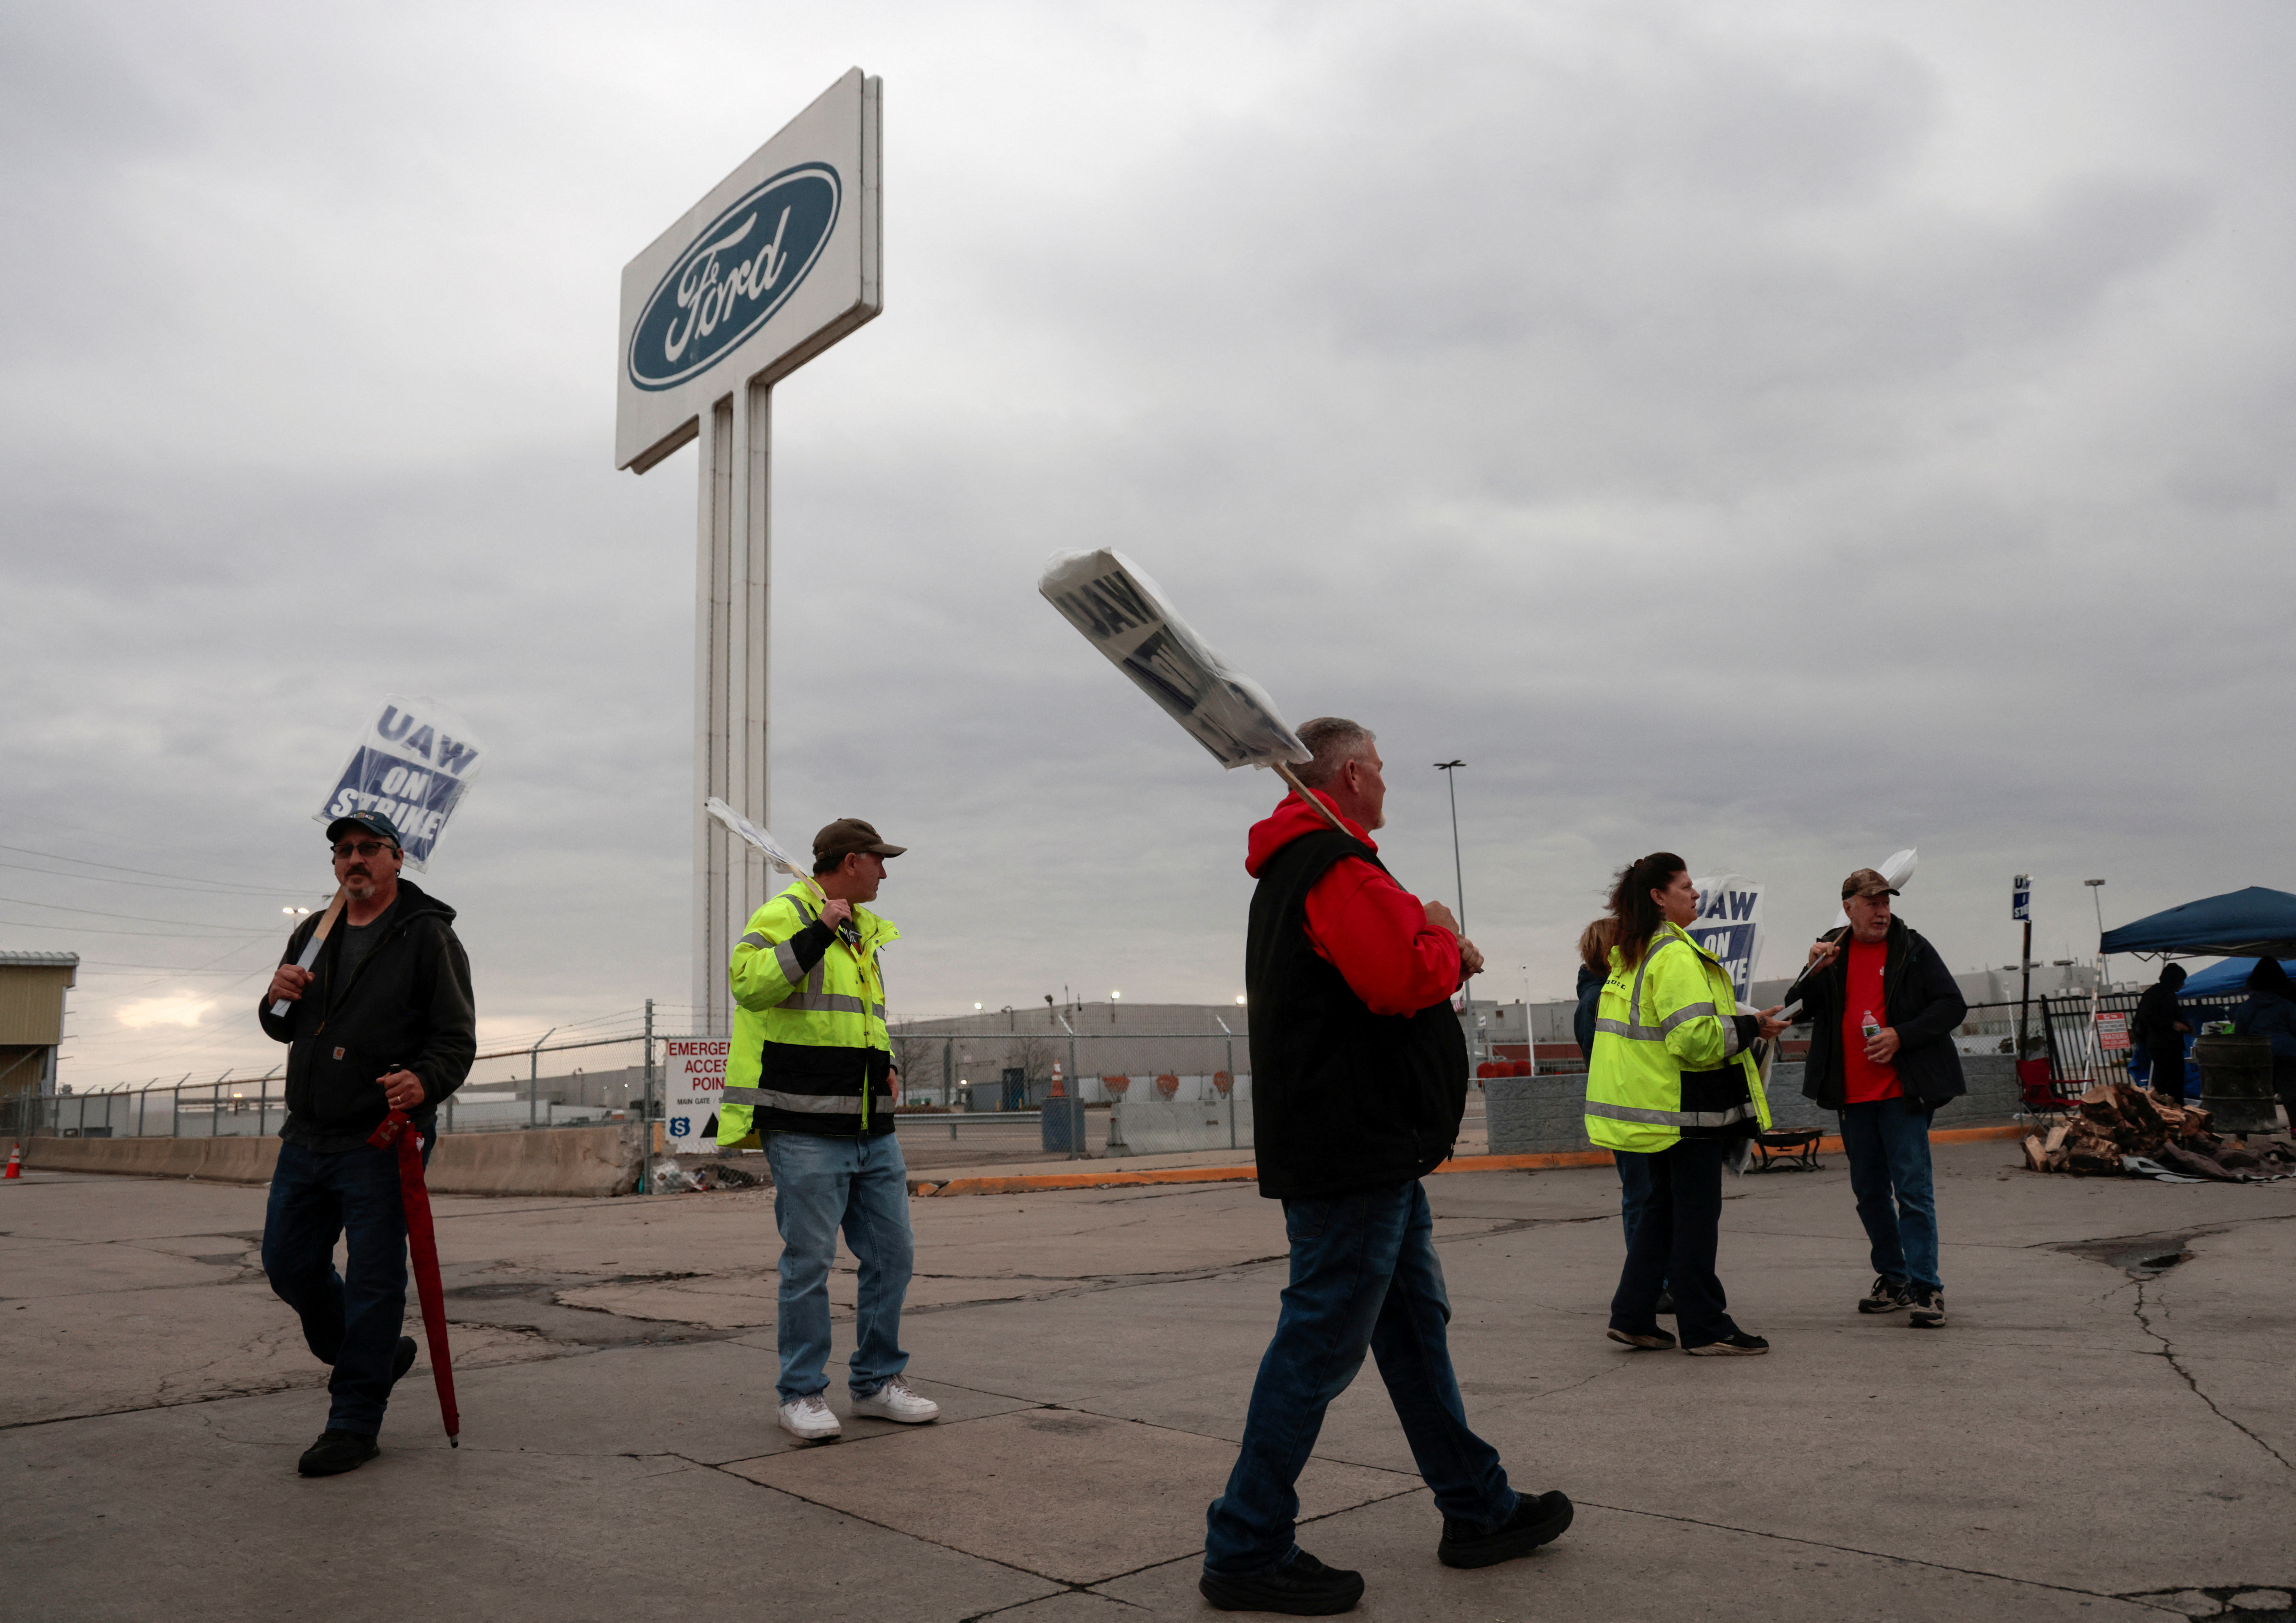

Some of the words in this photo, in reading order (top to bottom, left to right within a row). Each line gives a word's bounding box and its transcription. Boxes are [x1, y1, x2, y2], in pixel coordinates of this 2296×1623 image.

[665, 205, 791, 362] Ford
[1054, 570, 1159, 641] UAW
[377, 704, 479, 776] UAW
[381, 766, 431, 801] ON
[330, 788, 443, 840] STRIKE
[1704, 931, 1731, 958] ON
[693, 1077, 726, 1090] POIN
